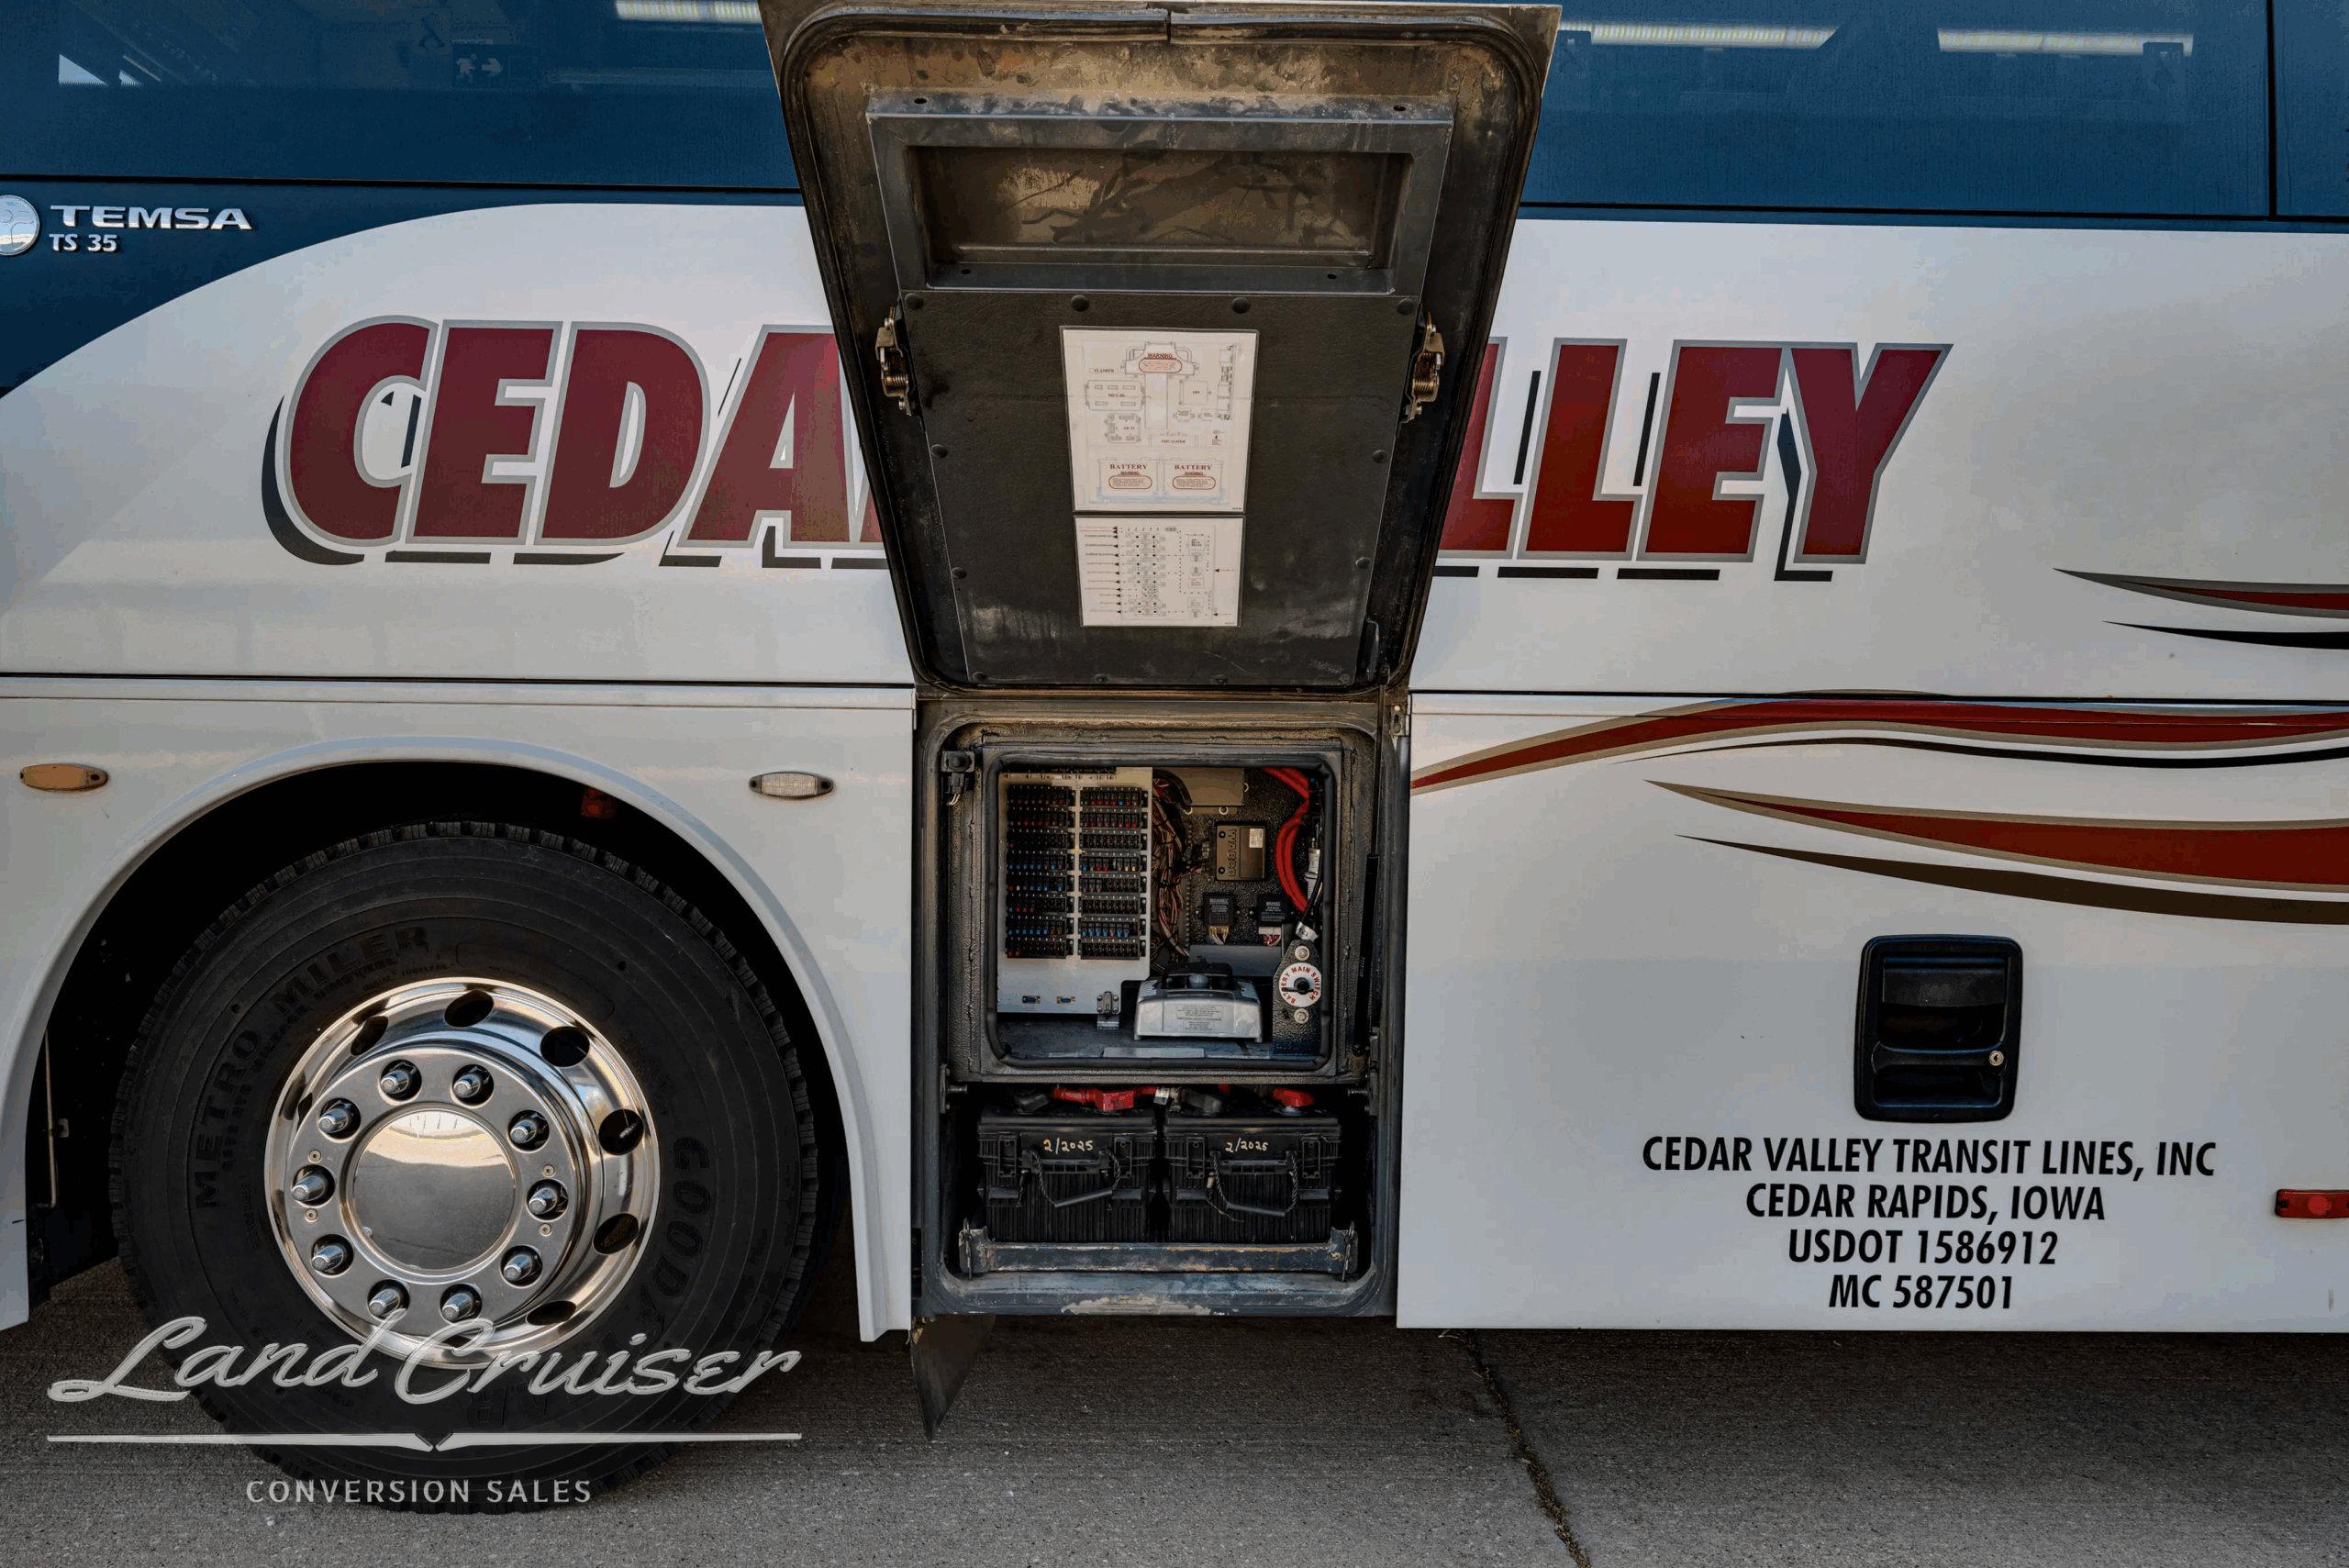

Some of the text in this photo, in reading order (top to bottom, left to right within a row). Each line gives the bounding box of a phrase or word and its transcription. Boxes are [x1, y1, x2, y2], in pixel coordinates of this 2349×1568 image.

[50, 205, 251, 229] TEMSA
[49, 233, 117, 251] TS 35
[268, 315, 892, 562] CEDA
[1228, 828, 1237, 878] WABCO
[1280, 973, 1296, 1004] BATERY
[1309, 972, 1320, 1001] SWITCH
[195, 926, 430, 1208] METRO MILER
[1042, 1138, 1094, 1154] 2/2025
[1225, 1138, 1269, 1152] 2/2025
[1642, 1136, 2216, 1181] CEDAR VALLEY TRANSIT LINES, INC
[1746, 1183, 2104, 1225] CEDAR RAPIDS, IOWA
[1788, 1229, 2057, 1264] USDOT 1586912
[1829, 1274, 2011, 1308] MC 587501
